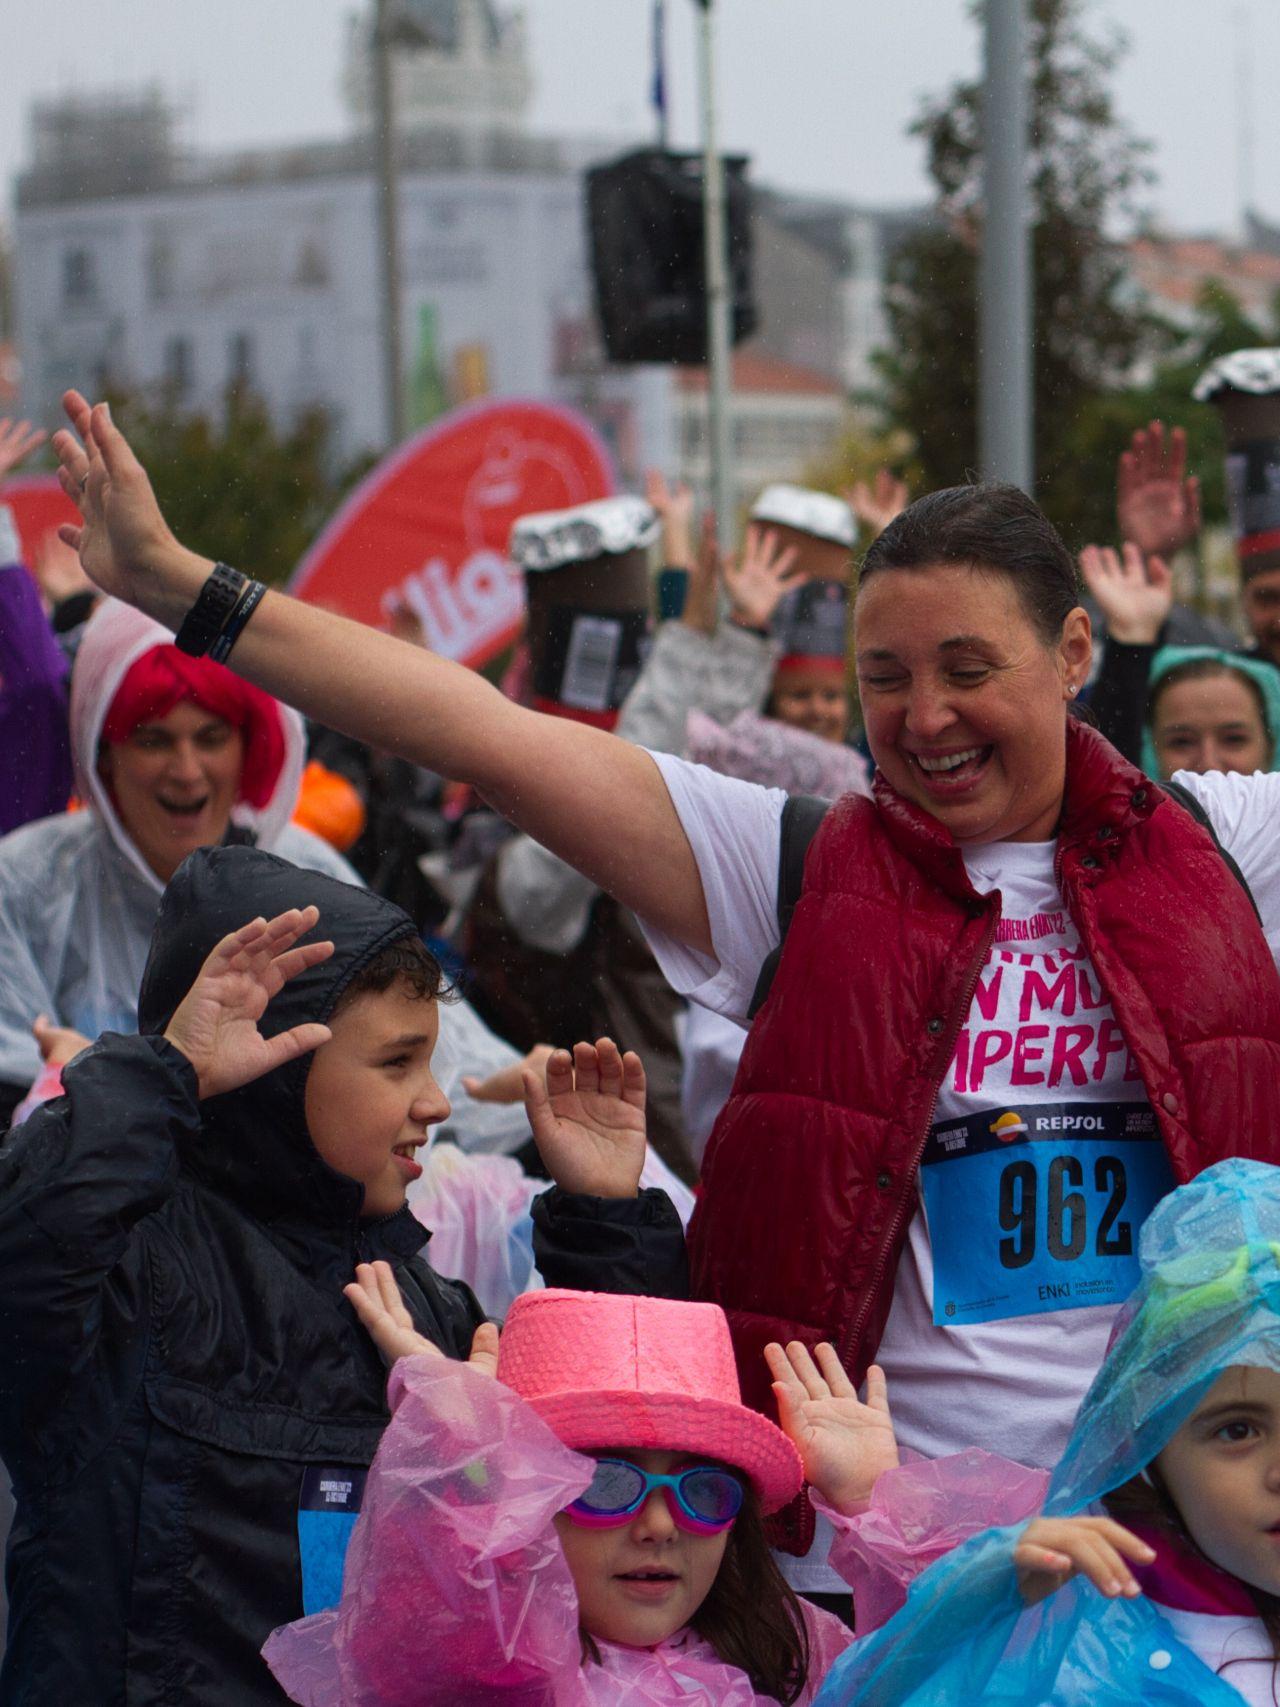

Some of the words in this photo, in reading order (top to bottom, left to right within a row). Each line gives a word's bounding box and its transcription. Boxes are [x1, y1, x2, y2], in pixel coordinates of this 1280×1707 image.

[965, 965, 1003, 1024] N
[1036, 1115, 1105, 1132] REPSOL
[998, 1155, 1133, 1270] 962
[1038, 1282, 1070, 1301] ENKI
